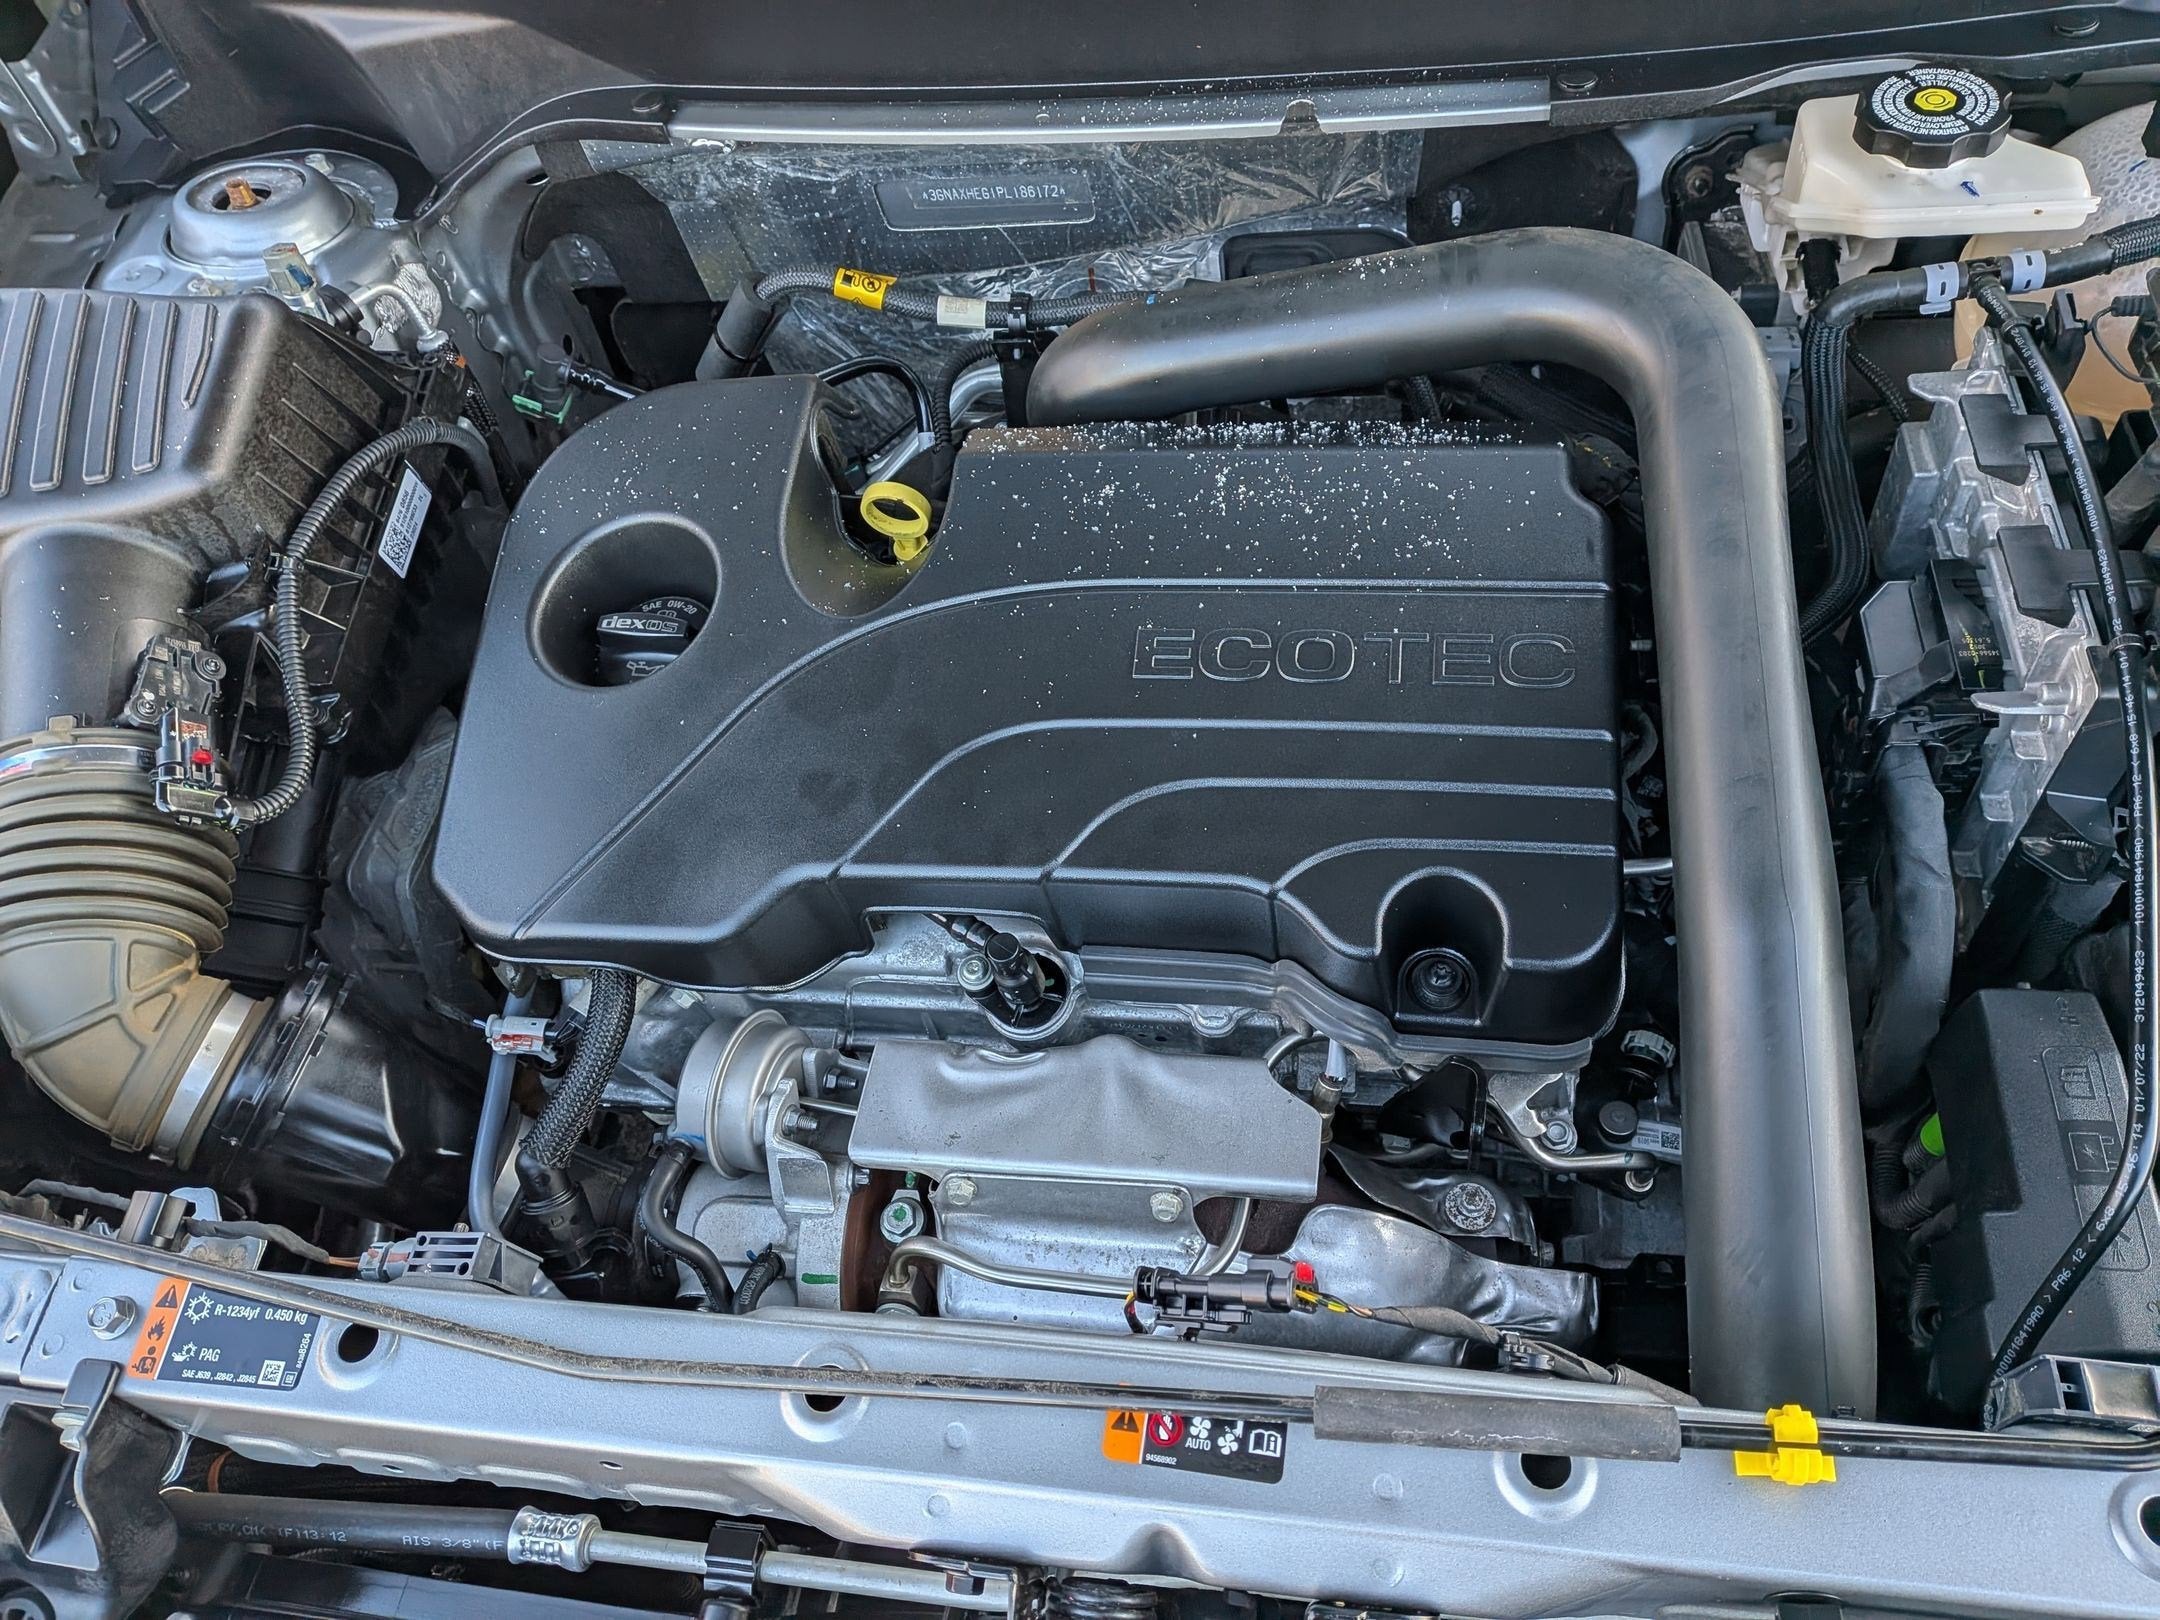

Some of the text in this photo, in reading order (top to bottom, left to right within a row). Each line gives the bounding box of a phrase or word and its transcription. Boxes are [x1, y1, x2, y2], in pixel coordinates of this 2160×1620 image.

[1911, 74, 1935, 82] ONLY
[1918, 80, 1948, 88] FILLER
[1954, 69, 1987, 85] SEALED
[2011, 328, 2031, 358] 01/07/2
[2097, 549, 2117, 605] 312049423
[642, 600, 697, 614] SAE 0W-20
[601, 616, 678, 633] dexos
[2113, 618, 2129, 668] 01//22
[1132, 627, 1576, 689] ECOTEC
[2129, 733, 2139, 754] 6x8
[2135, 950, 2145, 1023] 312049423
[2096, 1205, 2115, 1231] 6x8
[2115, 1123, 2143, 1198] 15:46:14
[2135, 1044, 2145, 1112] 01/07/22
[214, 1303, 309, 1326] R-1234yf 0.450 kg
[199, 1348, 221, 1362] PAG
[182, 1369, 195, 1379] SAE
[1185, 1437, 1212, 1451] AUTO
[402, 1535, 431, 1547] AIS
